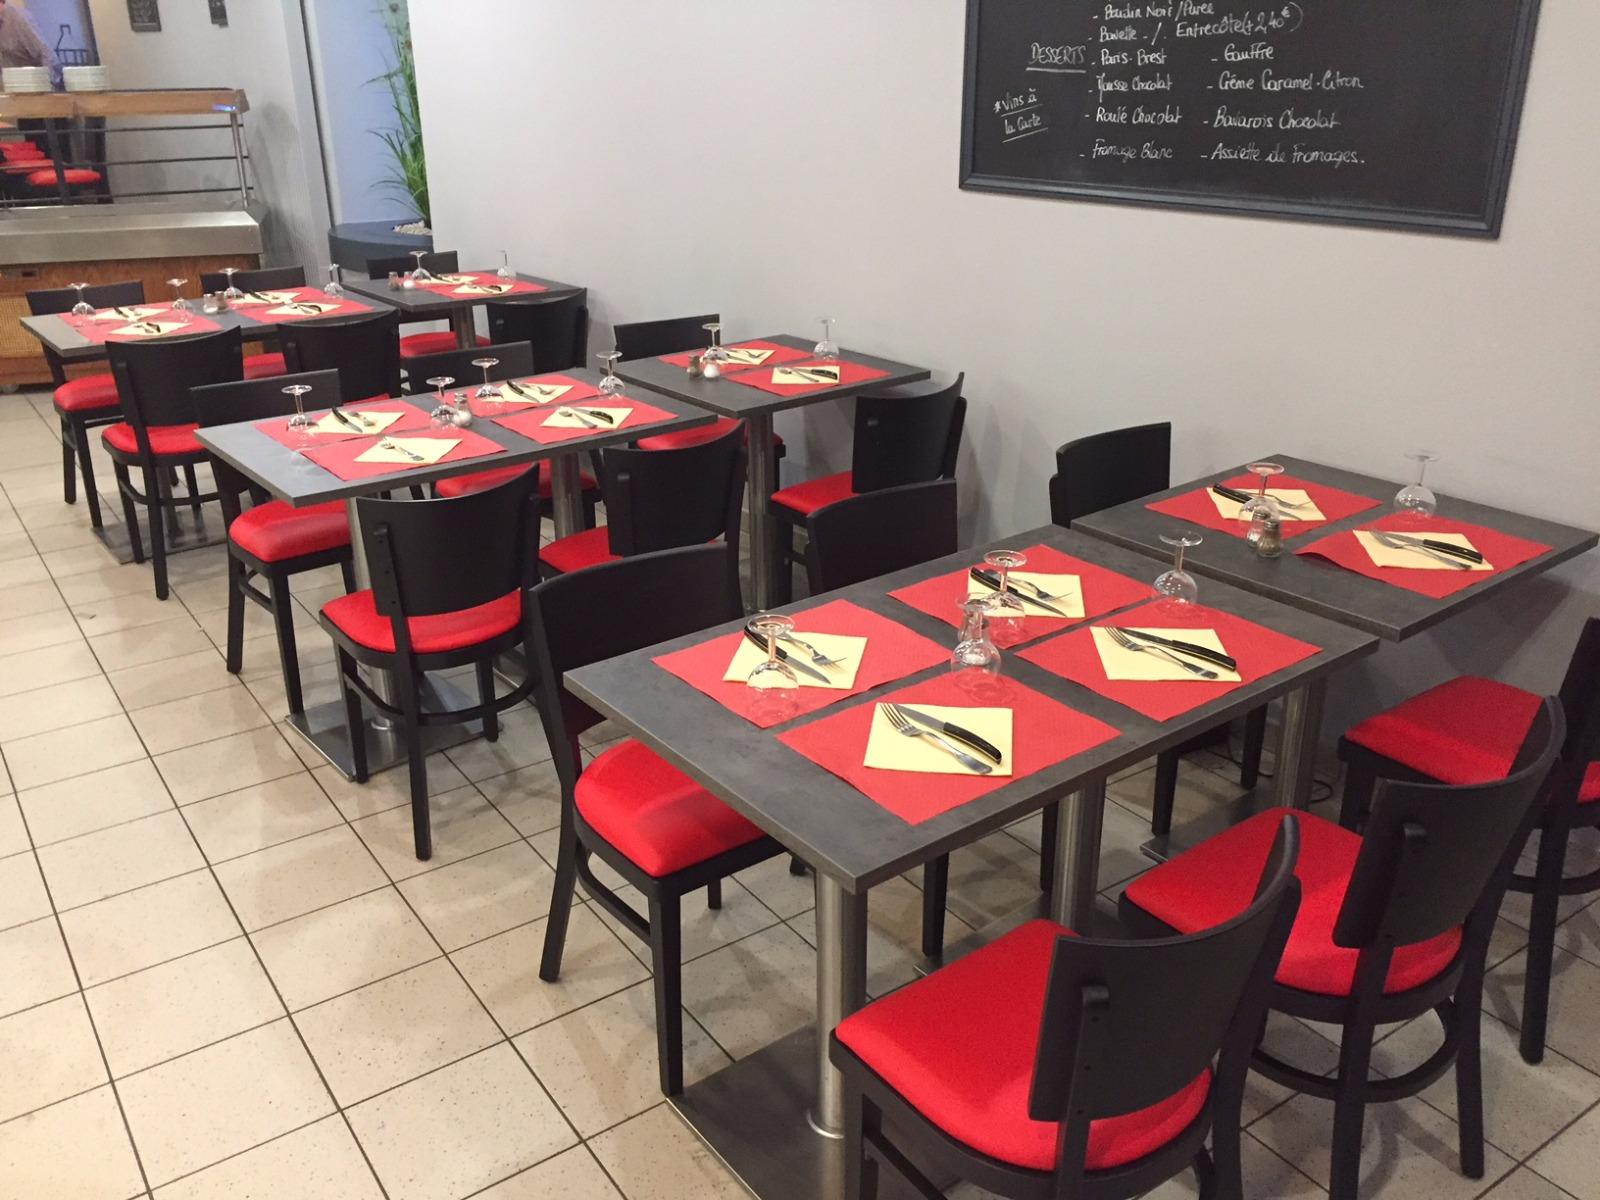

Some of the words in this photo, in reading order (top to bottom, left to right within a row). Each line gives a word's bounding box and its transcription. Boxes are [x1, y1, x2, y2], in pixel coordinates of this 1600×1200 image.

[1029, 42, 1087, 65] DESSERTS
[1132, 72, 1173, 91] Chocolat
[1004, 119, 1016, 135] la
[1017, 113, 1042, 131] Carte
[1095, 105, 1128, 123] Roulé
[1132, 104, 1183, 125] Chocolat
[1278, 107, 1341, 130] Chocolat
[1092, 138, 1137, 164] Fromage
[1140, 139, 1173, 161] Blanc
[1211, 142, 1261, 162] Assiette
[1265, 143, 1287, 164] de
